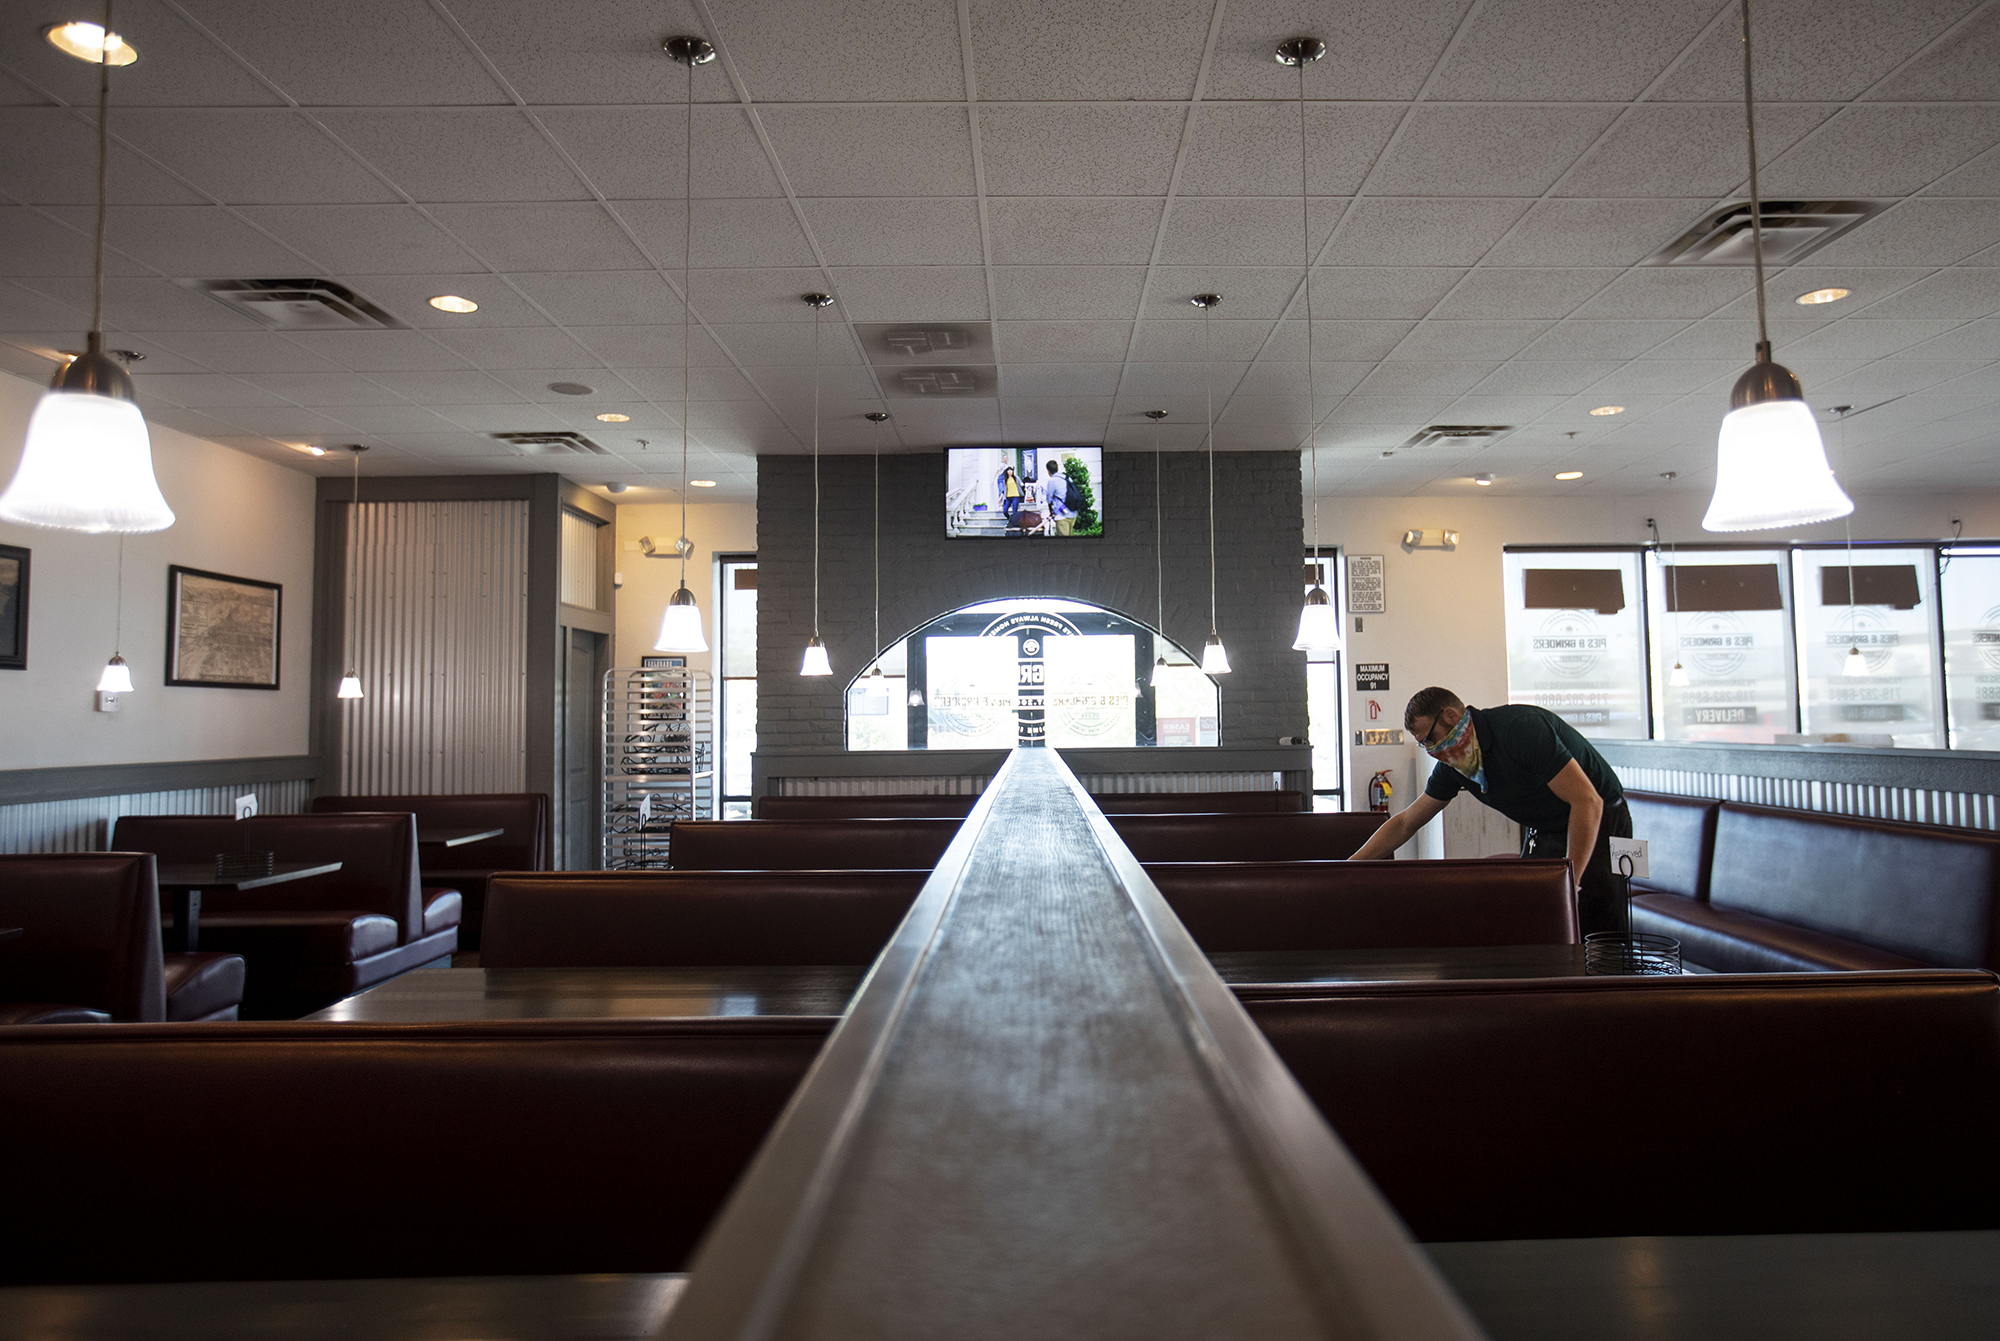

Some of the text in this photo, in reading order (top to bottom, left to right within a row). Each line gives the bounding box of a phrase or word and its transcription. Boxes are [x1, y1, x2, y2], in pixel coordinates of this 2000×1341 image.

[1360, 664, 1385, 672] MAXIMUM
[1356, 673, 1389, 681] OCCUPANCY
[1369, 681, 1377, 690] 91
